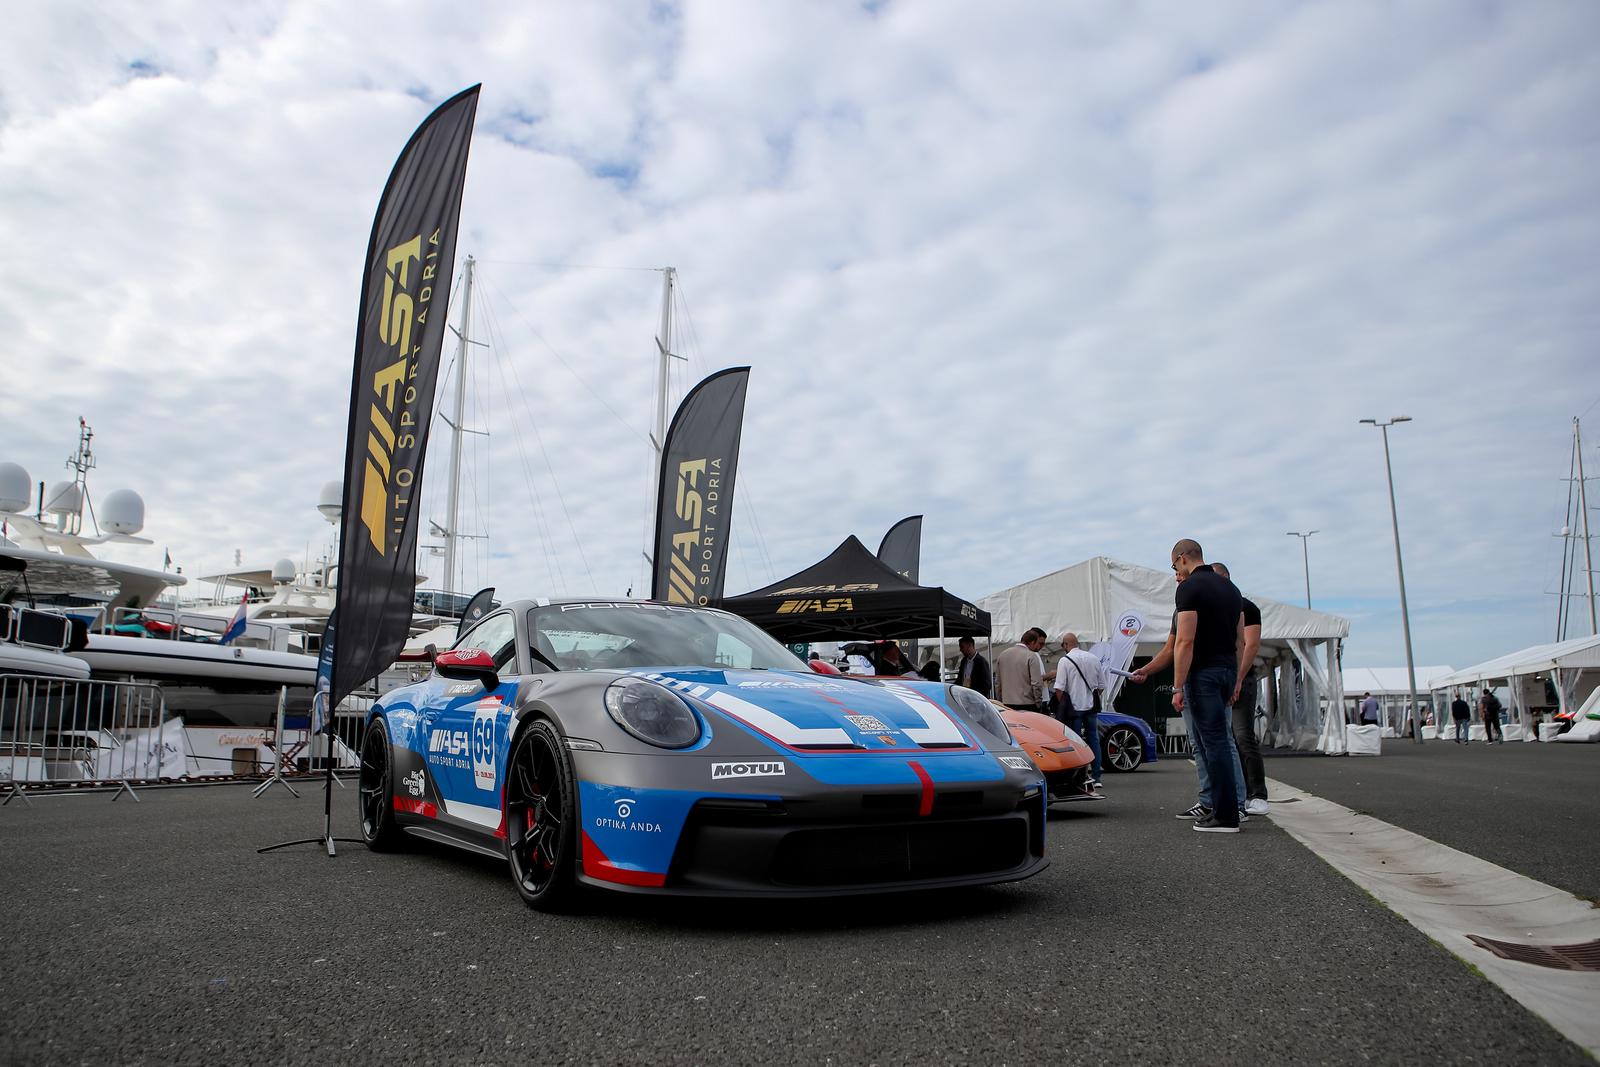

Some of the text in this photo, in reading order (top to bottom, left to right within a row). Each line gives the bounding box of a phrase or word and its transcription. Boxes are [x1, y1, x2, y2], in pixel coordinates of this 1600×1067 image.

[394, 228, 441, 553] TO SPORT ADRIA
[707, 458, 722, 516] ADRIA
[700, 524, 716, 586] SPORT
[429, 754, 471, 770] AUTO SPORT ADRIA
[474, 717, 494, 765] 69
[714, 763, 783, 777] MOTUL
[596, 817, 662, 833] OPTIKA ANDA
